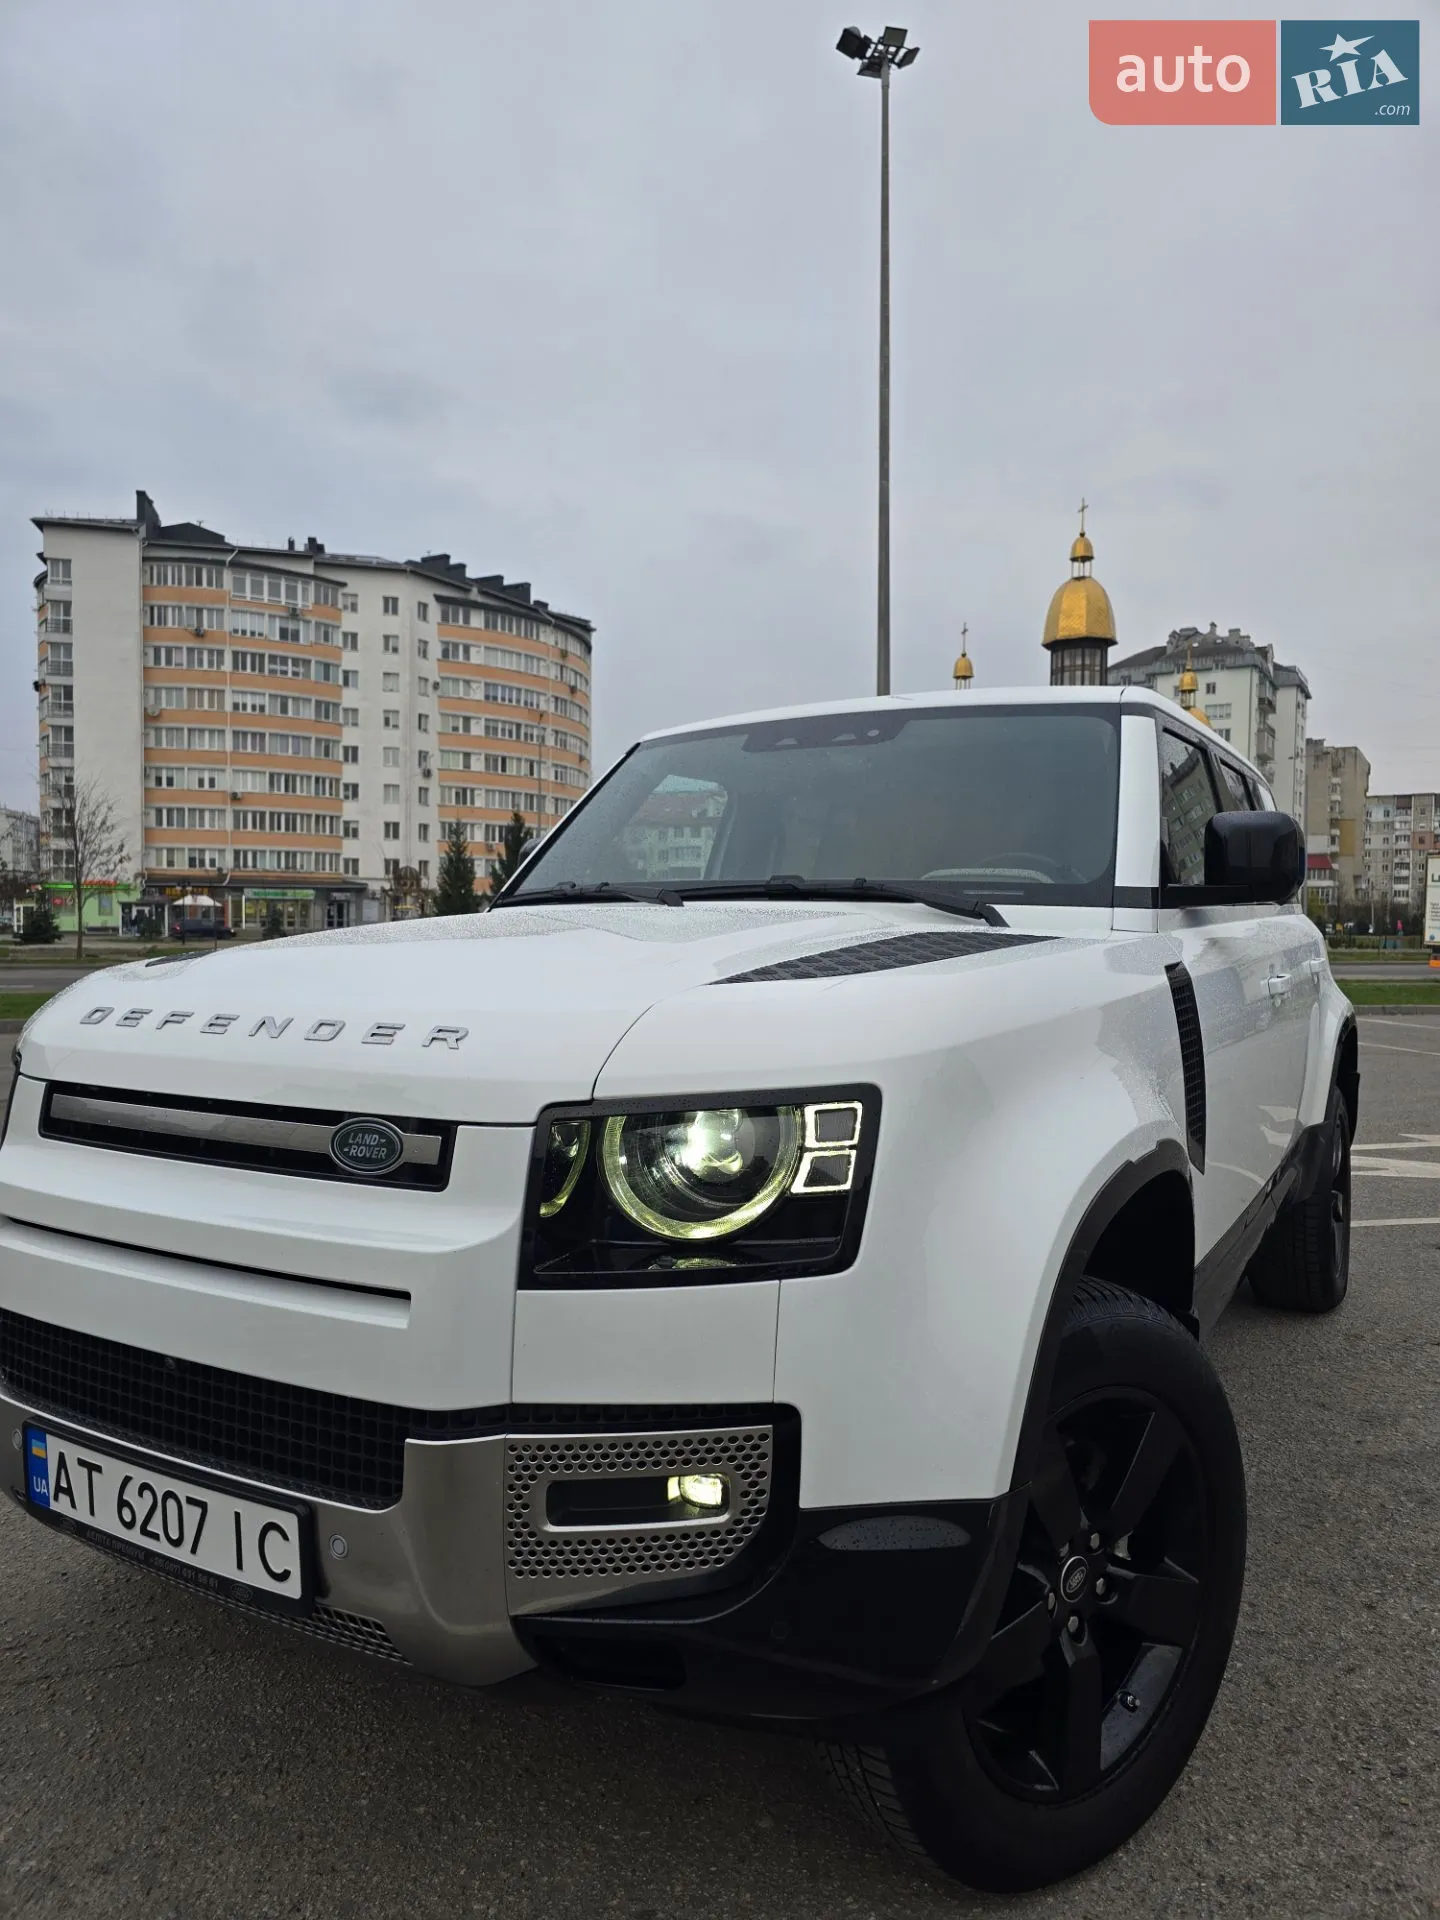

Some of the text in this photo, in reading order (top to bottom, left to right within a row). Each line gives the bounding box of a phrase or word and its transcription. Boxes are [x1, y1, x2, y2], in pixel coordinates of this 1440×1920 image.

[79, 1006, 470, 1050] DEFENDER
[33, 1475, 49, 1497] UA
[53, 1451, 103, 1517] AT
[117, 1474, 208, 1554] 6207
[233, 1510, 292, 1582] IC
